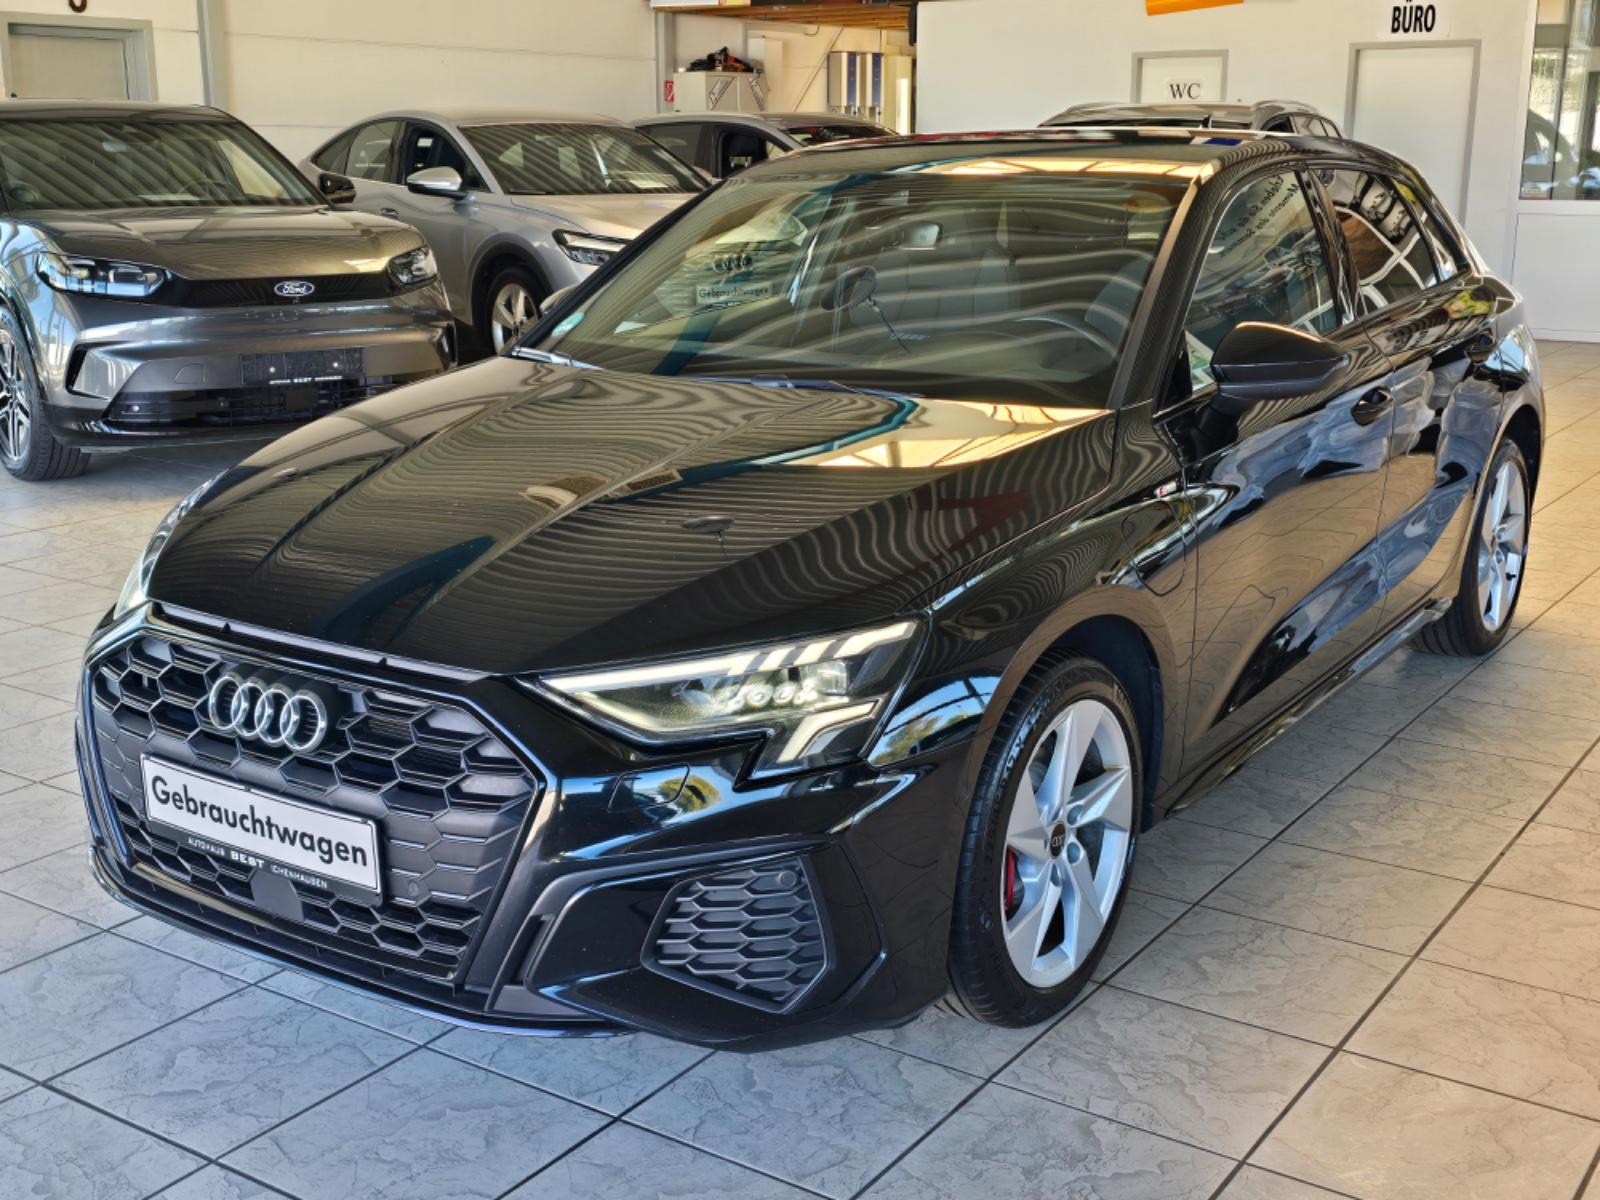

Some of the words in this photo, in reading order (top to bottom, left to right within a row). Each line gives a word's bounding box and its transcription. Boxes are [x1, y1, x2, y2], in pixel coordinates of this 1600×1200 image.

[1391, 0, 1436, 33] BÜRO
[1169, 83, 1201, 100] WC
[151, 775, 368, 867] Gebrauchtwagen
[231, 850, 265, 868] BEST
